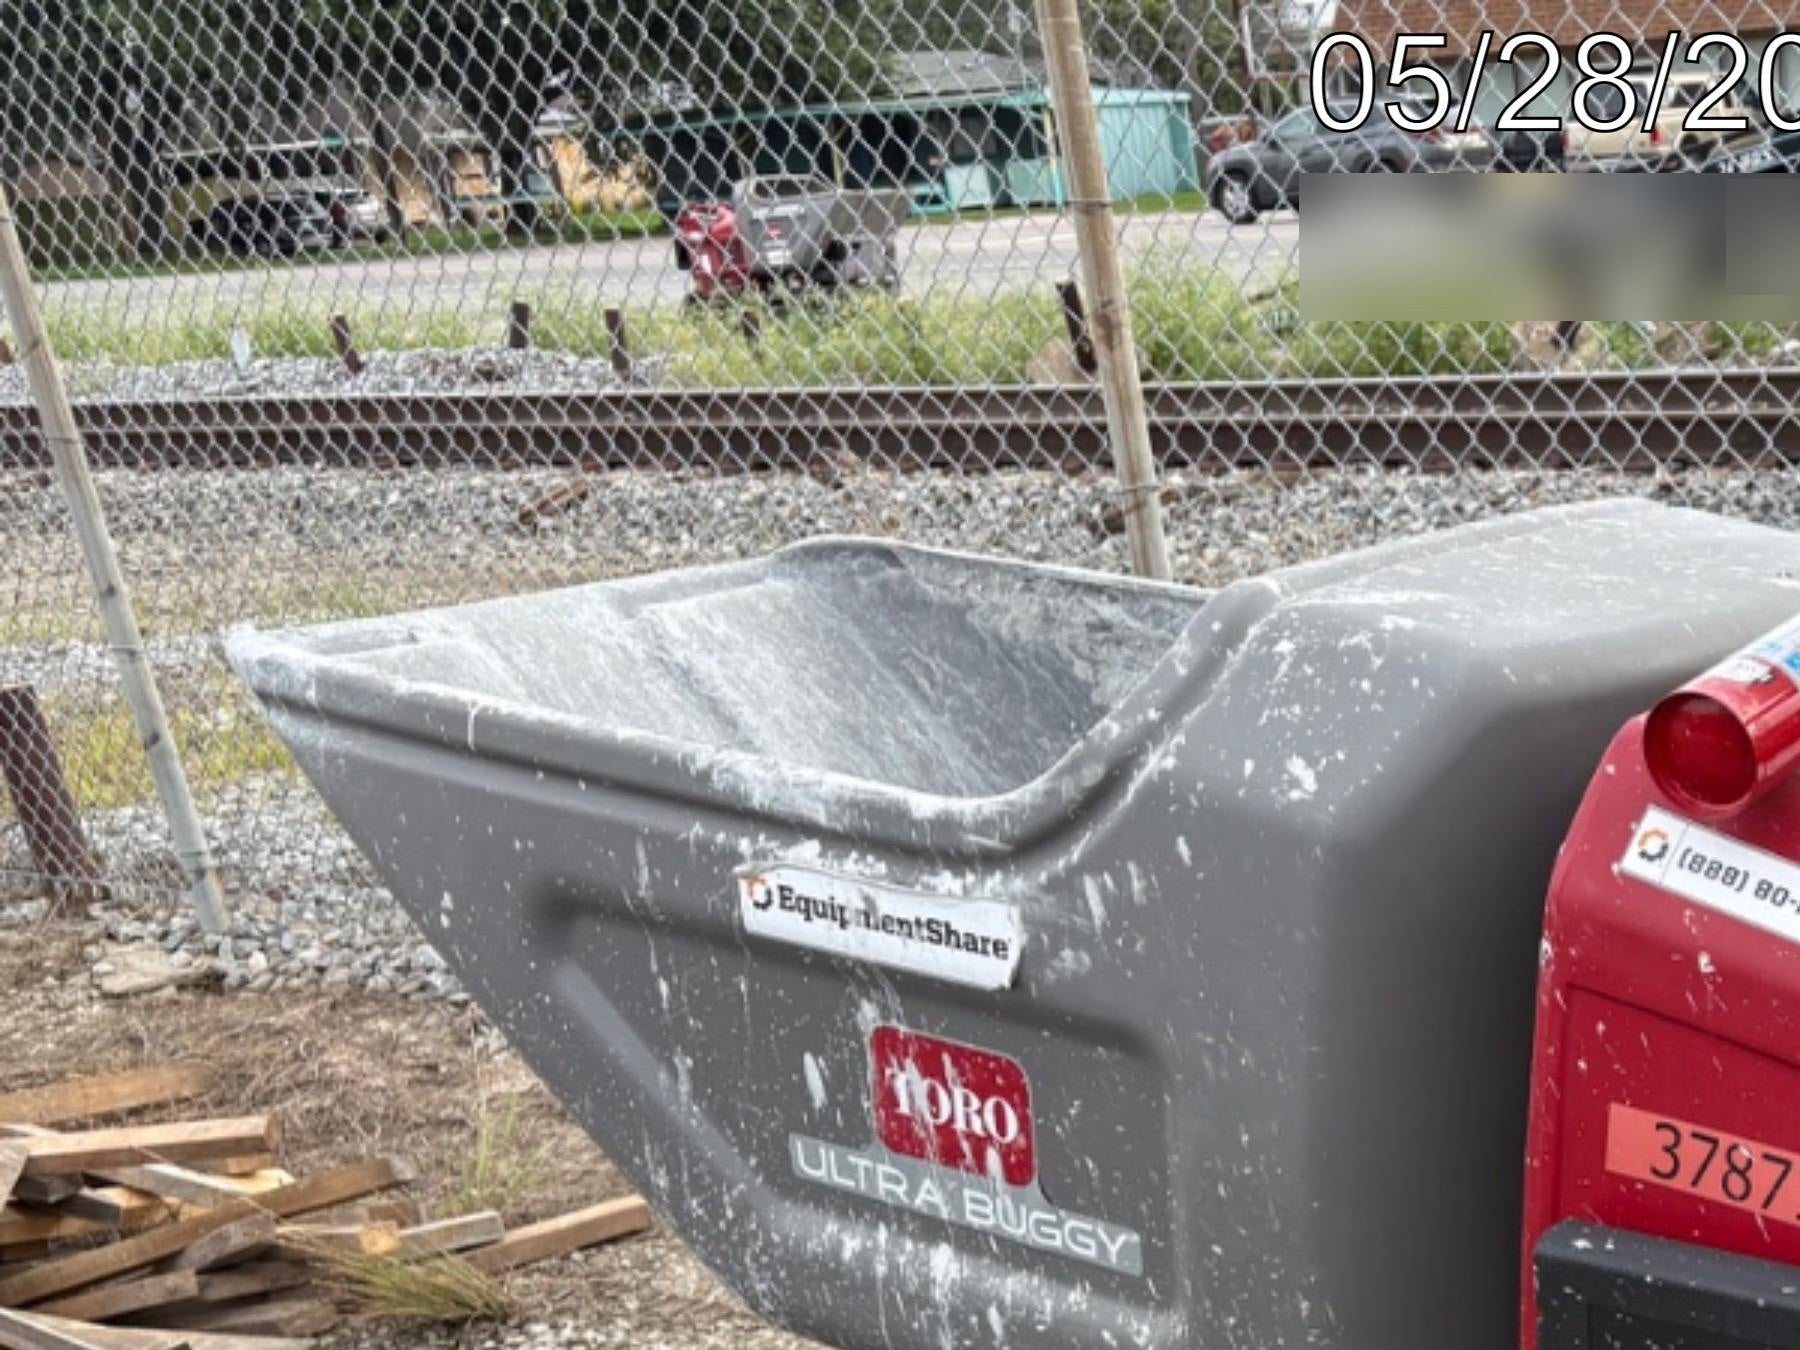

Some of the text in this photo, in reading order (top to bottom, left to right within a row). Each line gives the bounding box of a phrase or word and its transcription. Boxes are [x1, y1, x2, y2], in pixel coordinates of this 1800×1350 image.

[1676, 846, 1751, 893] (888)
[883, 1064, 1020, 1145] TORO
[796, 1138, 1138, 1267] ULTRA BUGGY
